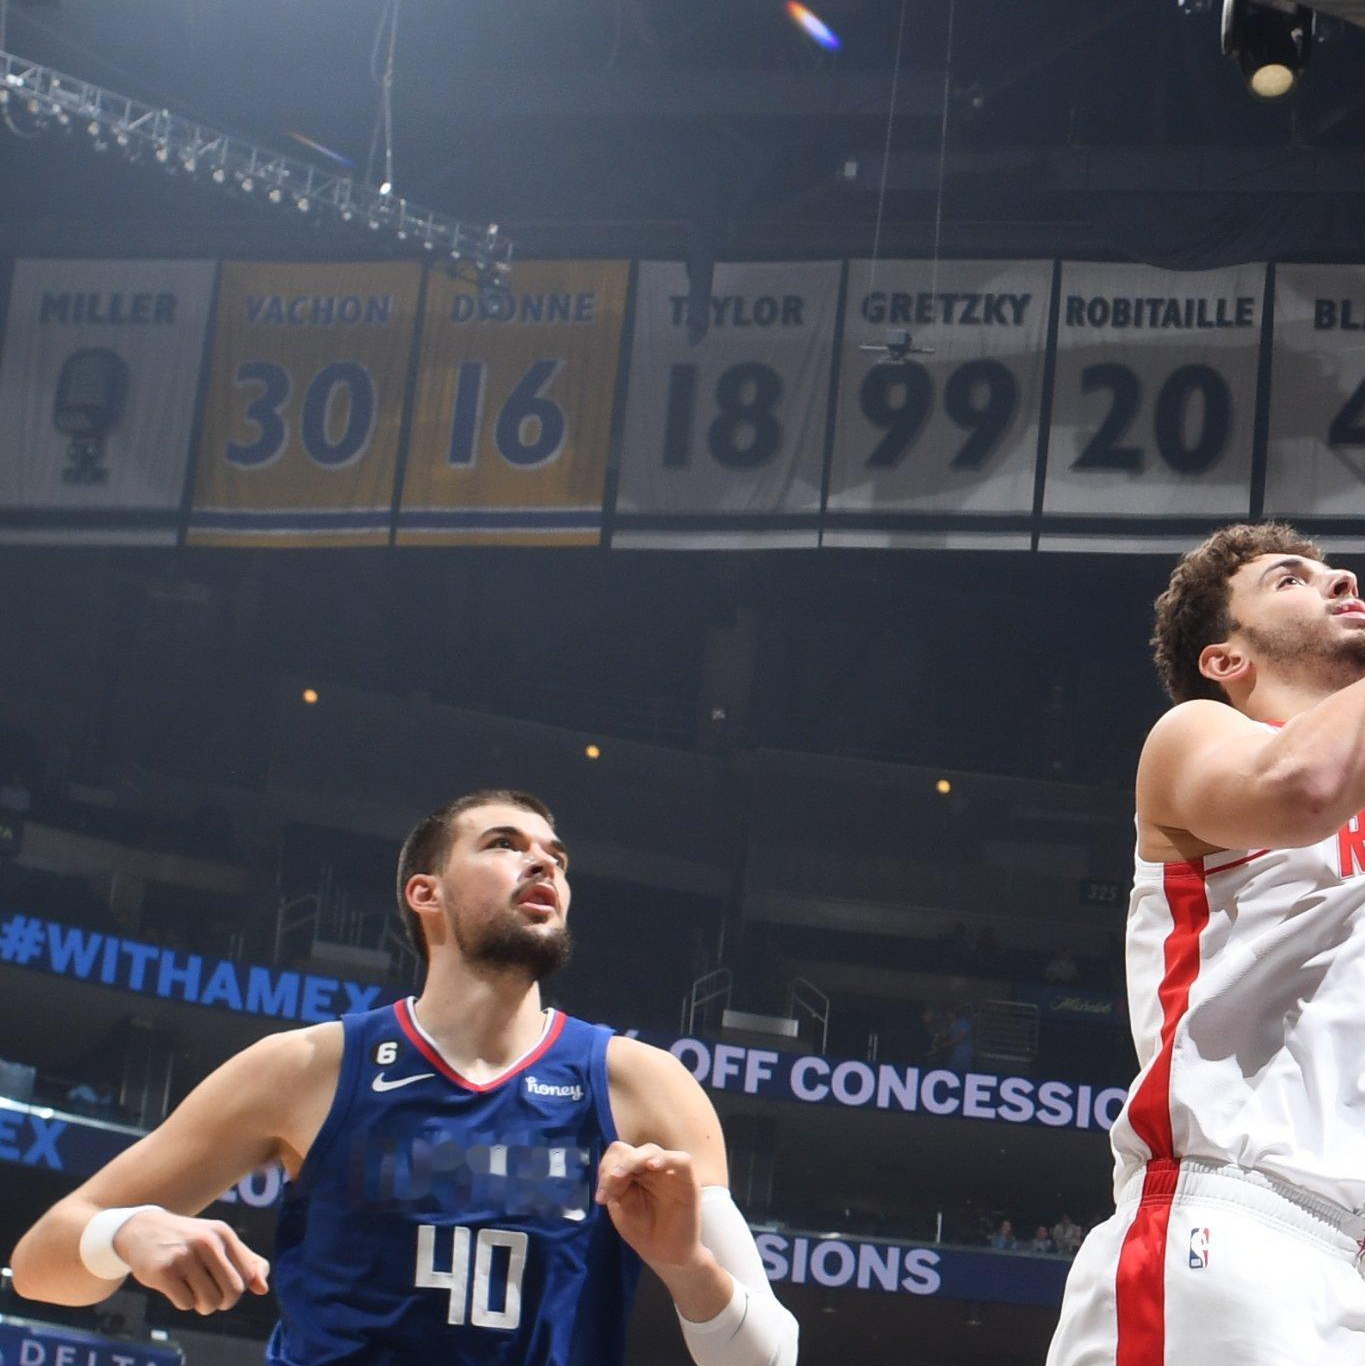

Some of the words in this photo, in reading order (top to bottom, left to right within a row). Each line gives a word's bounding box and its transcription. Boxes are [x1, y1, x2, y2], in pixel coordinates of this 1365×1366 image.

[40, 292, 177, 325] MILLER
[246, 294, 391, 327] VACHON
[861, 292, 1031, 326] GRETZKY
[1066, 295, 1254, 329] ROBITAILLE
[225, 360, 375, 469] 30
[446, 359, 567, 470] 16
[663, 361, 784, 469] 18
[859, 357, 1020, 469] 99
[1069, 362, 1233, 474] 20
[1, 914, 381, 1024] #WITHAMEX
[376, 1042, 397, 1065] 6
[526, 1076, 583, 1101] honey
[669, 1037, 778, 1094] OFF
[415, 1225, 528, 1329] 40
